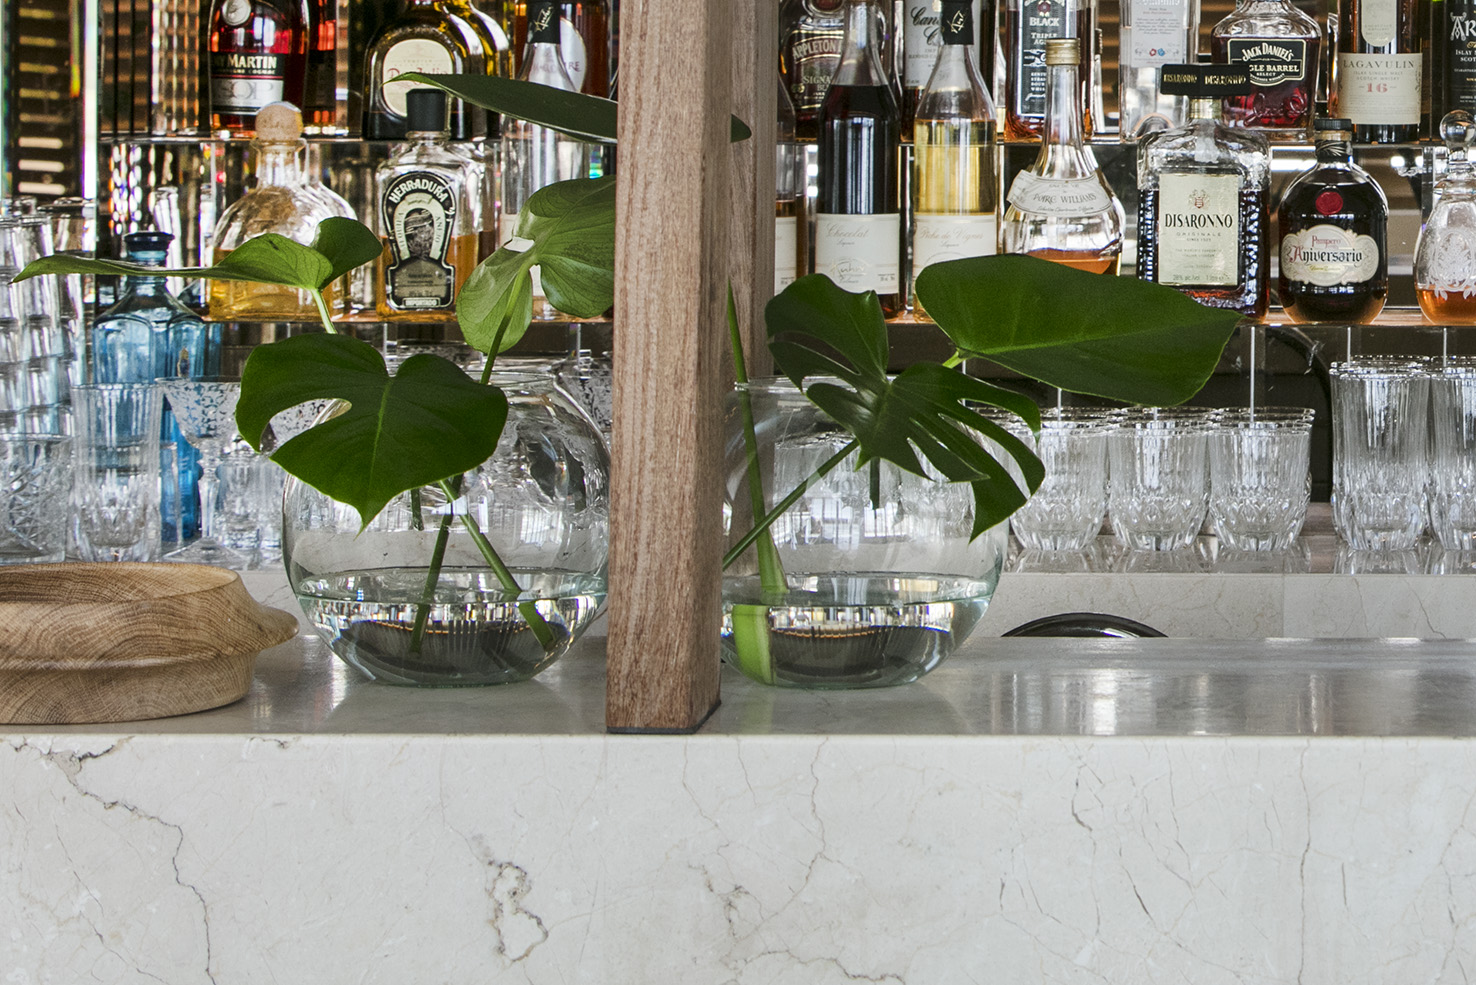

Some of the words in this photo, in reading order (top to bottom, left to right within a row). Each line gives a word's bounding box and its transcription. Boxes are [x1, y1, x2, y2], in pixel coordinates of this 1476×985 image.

[1029, 16, 1060, 27] BLACK
[792, 39, 837, 60] APPLETON
[1242, 45, 1262, 62] JACK
[1262, 42, 1294, 63] DANIEL'S
[228, 54, 277, 69] MARTIN
[1343, 59, 1415, 68] LAGAVULIN
[802, 76, 831, 84] SIGNA
[1367, 83, 1388, 93] 16
[388, 178, 449, 204] HERRADURA
[1060, 192, 1097, 204] WILLIAMS
[1165, 213, 1233, 229] DISARONNO
[1311, 235, 1340, 248] Pampero
[1289, 245, 1362, 266] Aniversario
